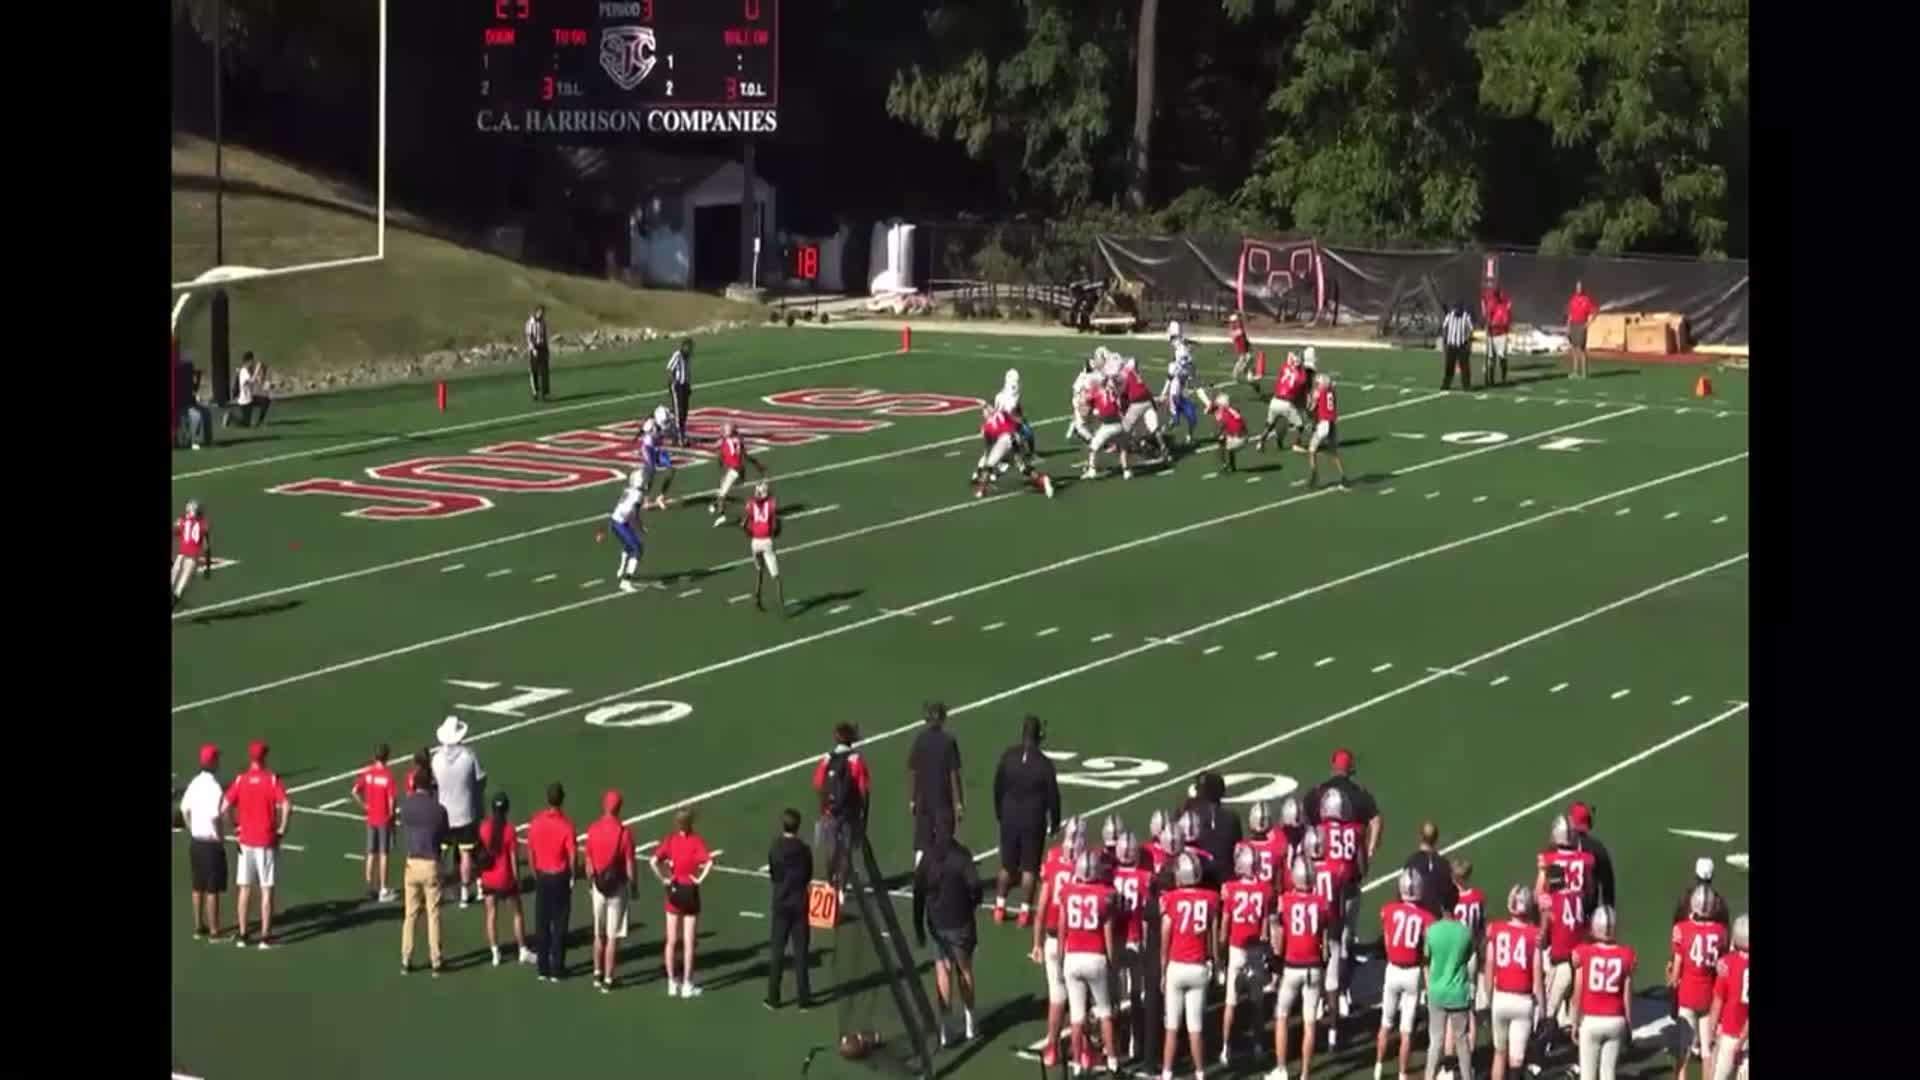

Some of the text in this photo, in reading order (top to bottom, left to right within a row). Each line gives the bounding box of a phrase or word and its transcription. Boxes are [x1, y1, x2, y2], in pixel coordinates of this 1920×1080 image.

[667, 54, 674, 70] 1
[665, 80, 674, 96] 2
[477, 110, 778, 133] C.A. HARRISON COMPANIES
[798, 247, 817, 279] 18
[183, 519, 201, 544] 14
[1329, 828, 1356, 860] 58
[810, 889, 833, 919] 20
[1067, 893, 1099, 930] 63
[1177, 900, 1208, 935] 79
[1232, 890, 1263, 924] 23
[1291, 903, 1319, 936] 81
[1392, 910, 1421, 949] 70
[1495, 932, 1527, 969] 84
[1690, 933, 1719, 967] 45
[1588, 957, 1622, 993] 62
